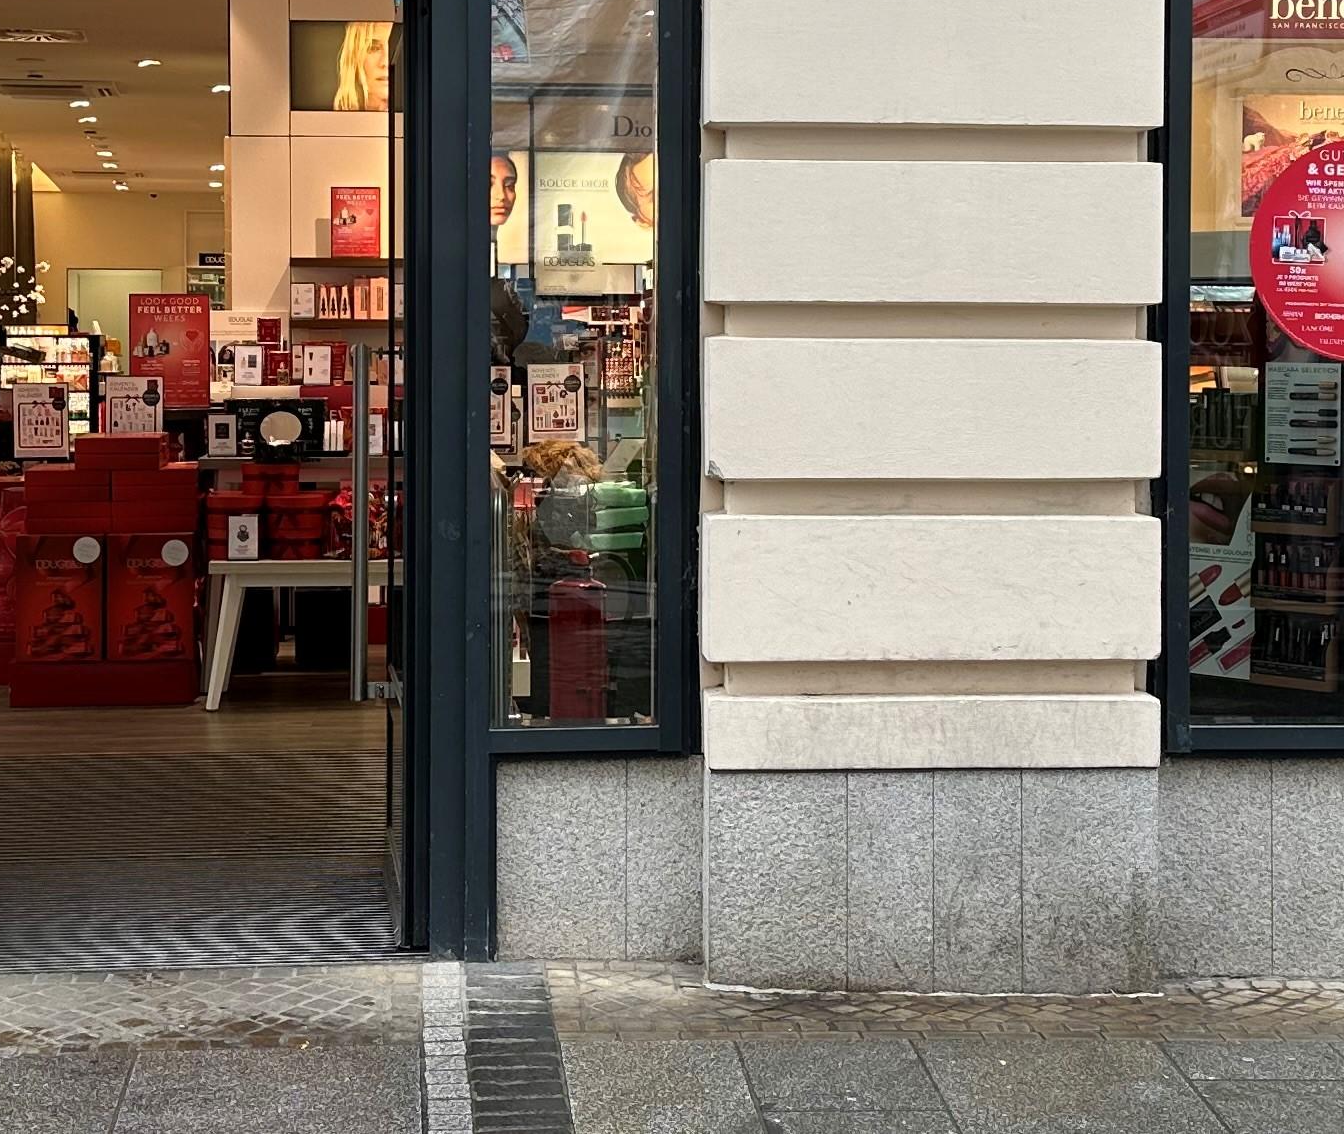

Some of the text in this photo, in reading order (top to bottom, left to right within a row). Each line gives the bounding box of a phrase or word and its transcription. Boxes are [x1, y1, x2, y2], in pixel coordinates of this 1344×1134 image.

[1272, 22, 1290, 30] SAN
[1307, 163, 1319, 175] &
[539, 178, 609, 188] ROUGE DIOR
[543, 256, 596, 267] DOUGLAS
[140, 297, 200, 305] LOOK GOOD
[137, 306, 203, 314] FEEL BETTER
[154, 315, 186, 323] WEEKS
